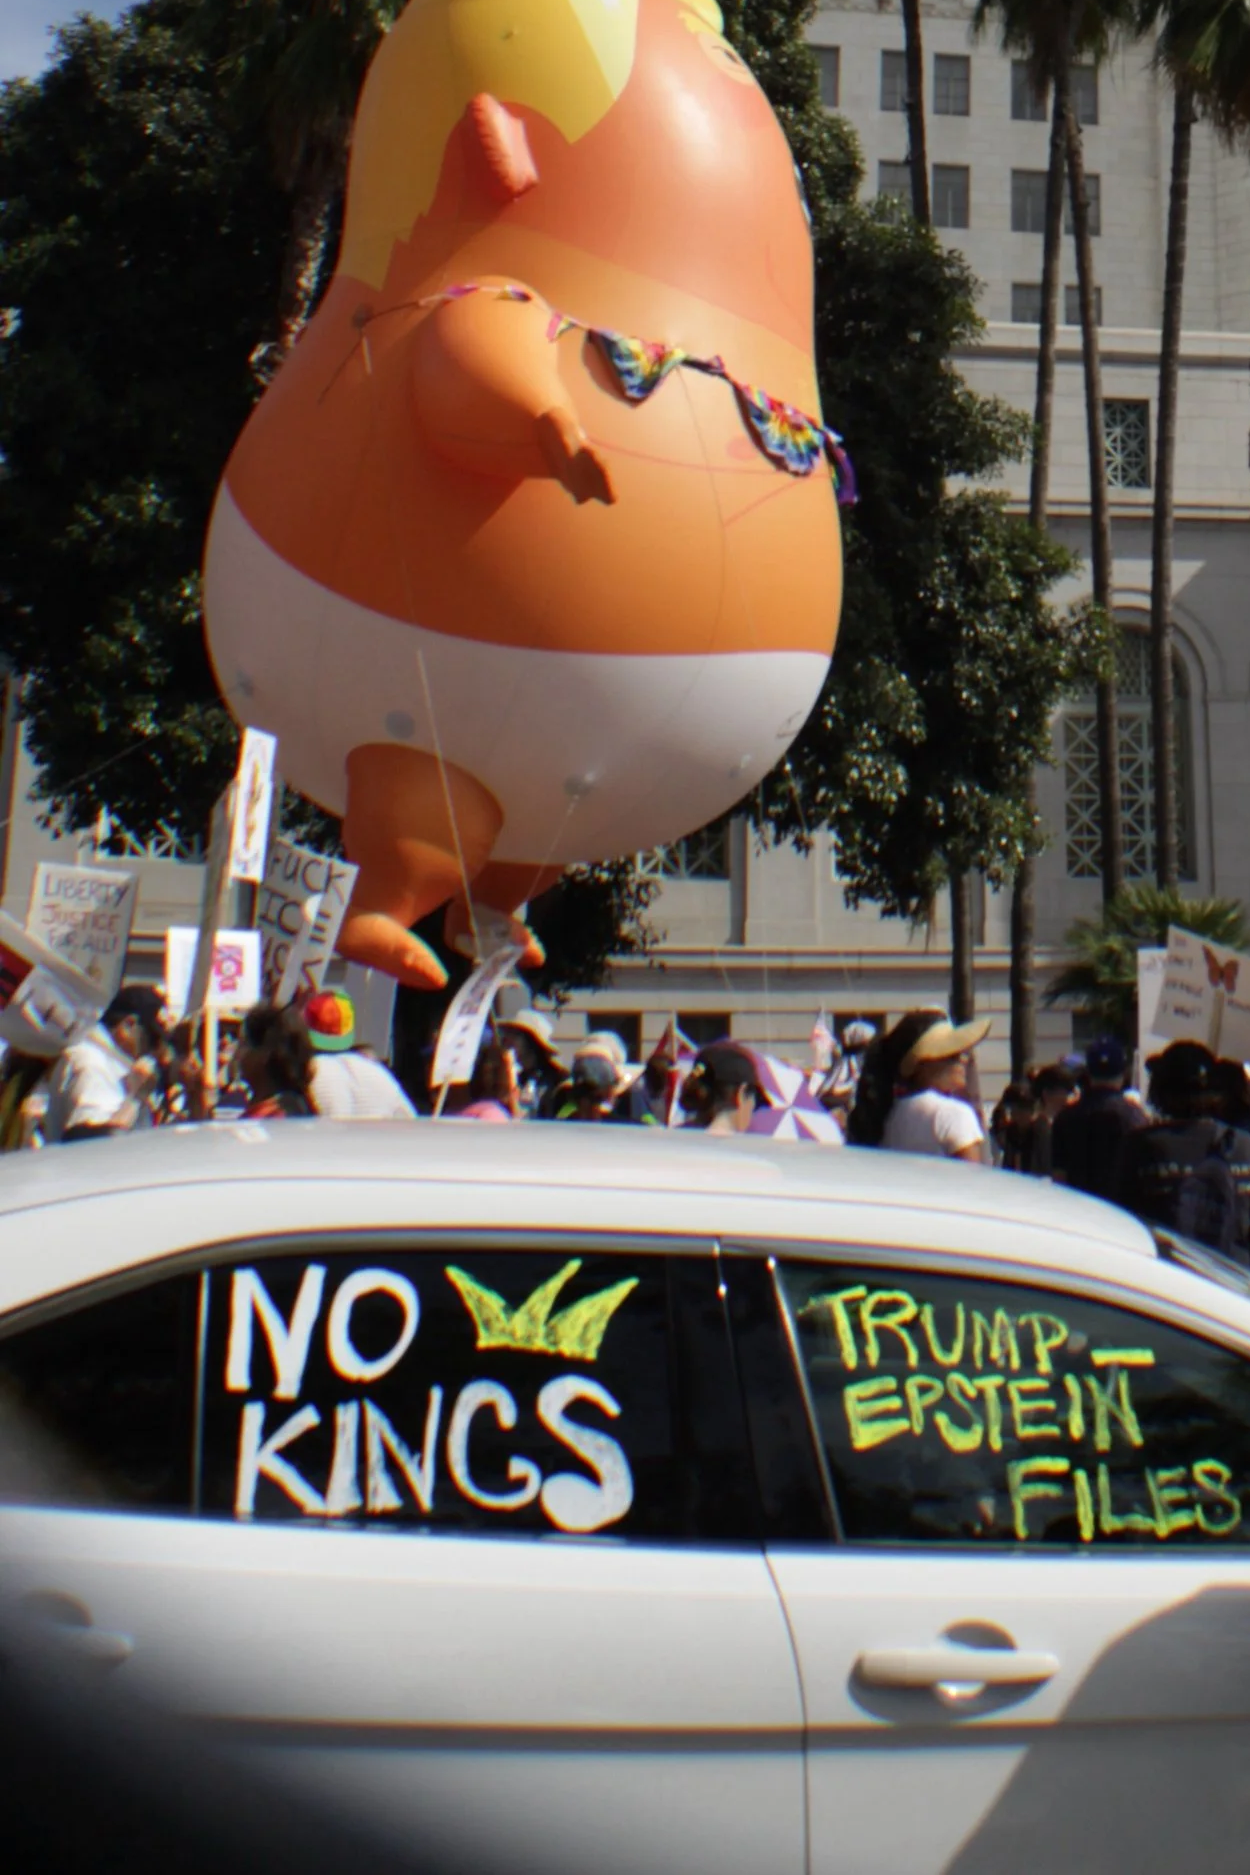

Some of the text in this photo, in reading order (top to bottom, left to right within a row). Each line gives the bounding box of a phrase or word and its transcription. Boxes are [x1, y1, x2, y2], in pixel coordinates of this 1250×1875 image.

[41, 903, 121, 932] JUSTICE
[44, 873, 130, 908] LIBERTY
[226, 1264, 420, 1401] NO
[844, 1371, 1144, 1453] EPSTEIN
[235, 1375, 634, 1534] KINGS
[1009, 1457, 1241, 1542] FILES
